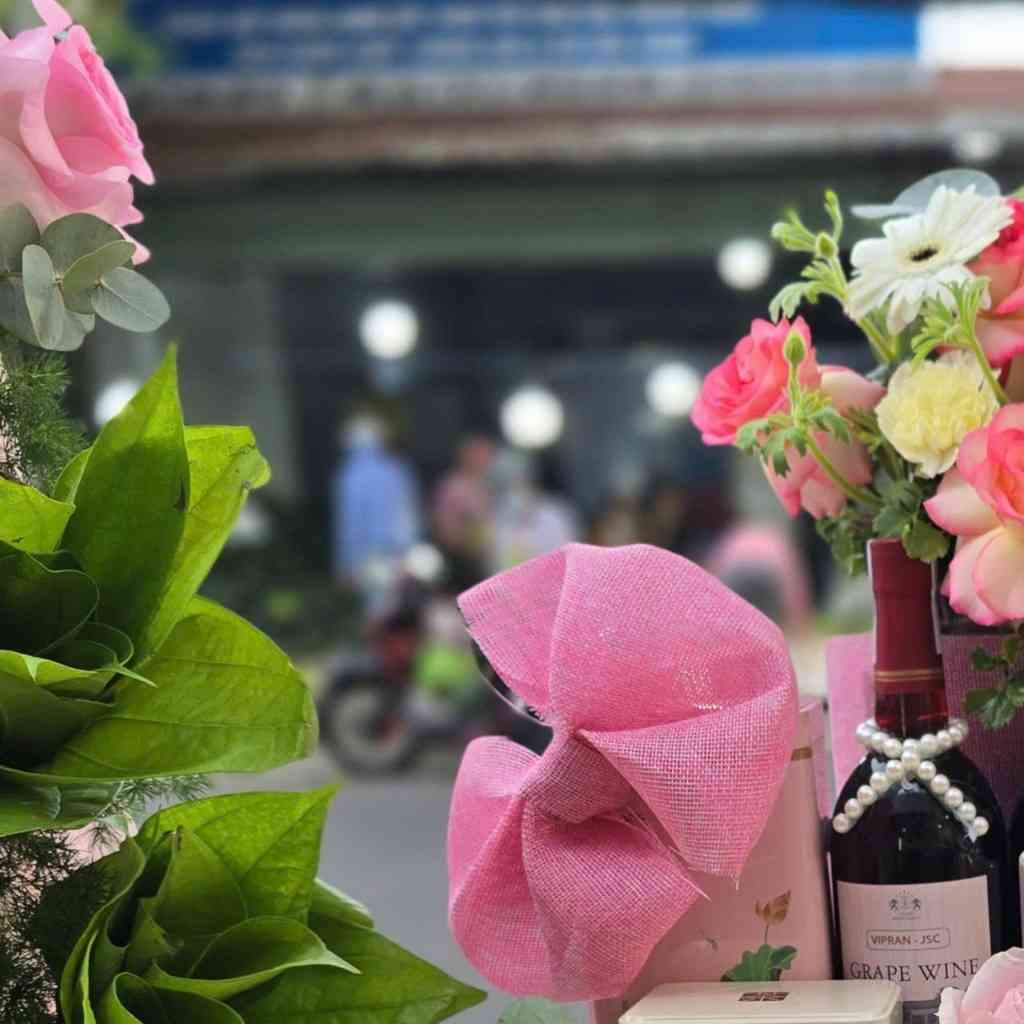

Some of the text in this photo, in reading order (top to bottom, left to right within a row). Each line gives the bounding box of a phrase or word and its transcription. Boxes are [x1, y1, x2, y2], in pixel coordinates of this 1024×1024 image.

[870, 934, 912, 946] VIPRAN
[919, 933, 942, 945] JSC
[849, 958, 980, 982] GRAPE WINE
